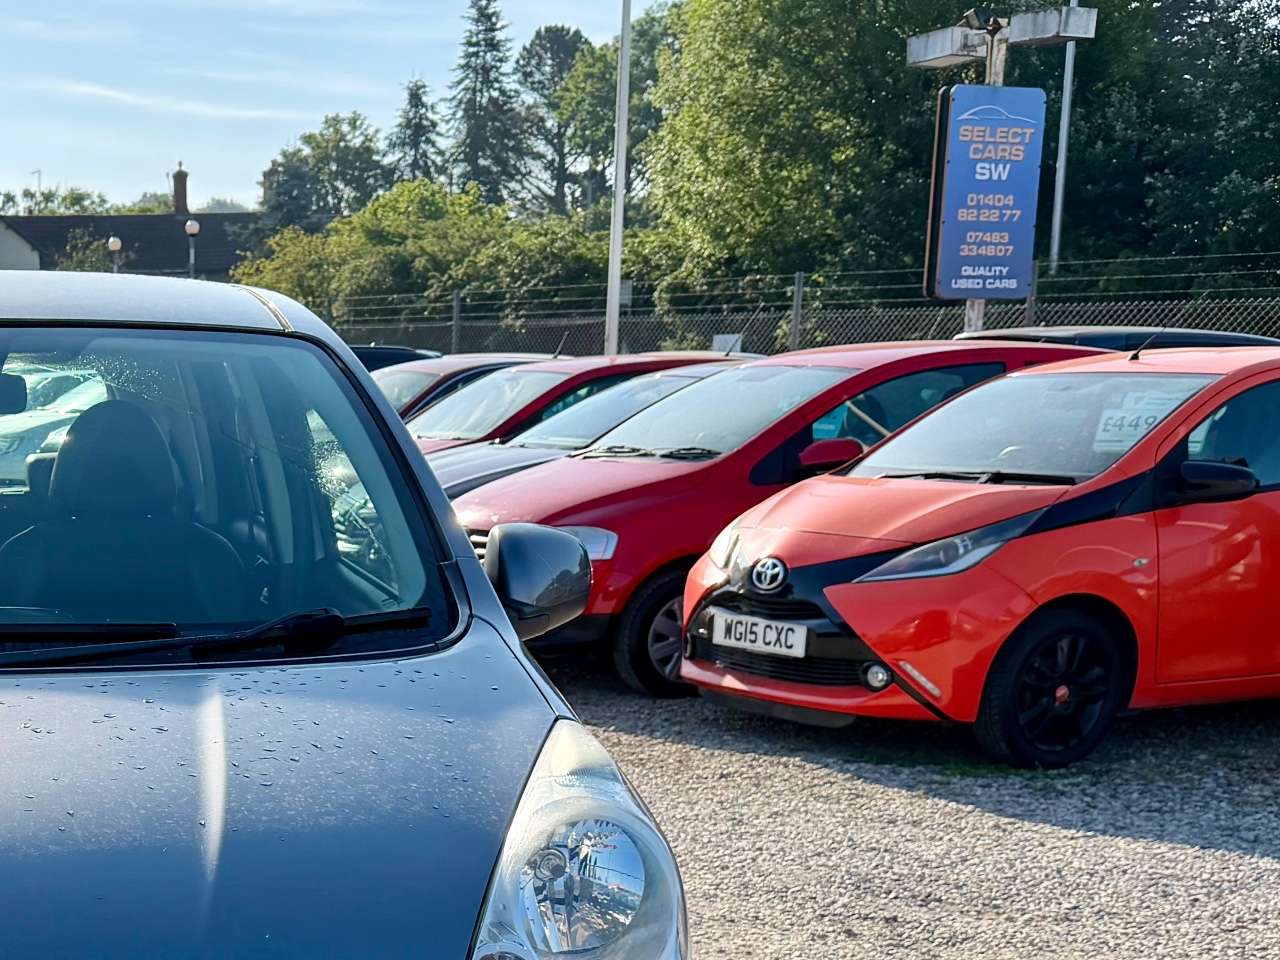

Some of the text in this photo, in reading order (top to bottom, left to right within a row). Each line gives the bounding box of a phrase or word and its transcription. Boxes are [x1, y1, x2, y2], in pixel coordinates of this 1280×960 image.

[959, 126, 1035, 143] SELECT
[969, 143, 1024, 161] CARS
[975, 162, 1011, 181] SW
[967, 193, 1014, 207] 01404
[961, 265, 1010, 277] QUALITY
[951, 278, 1017, 289] USED CARS
[723, 617, 795, 650] WG15 CXC
